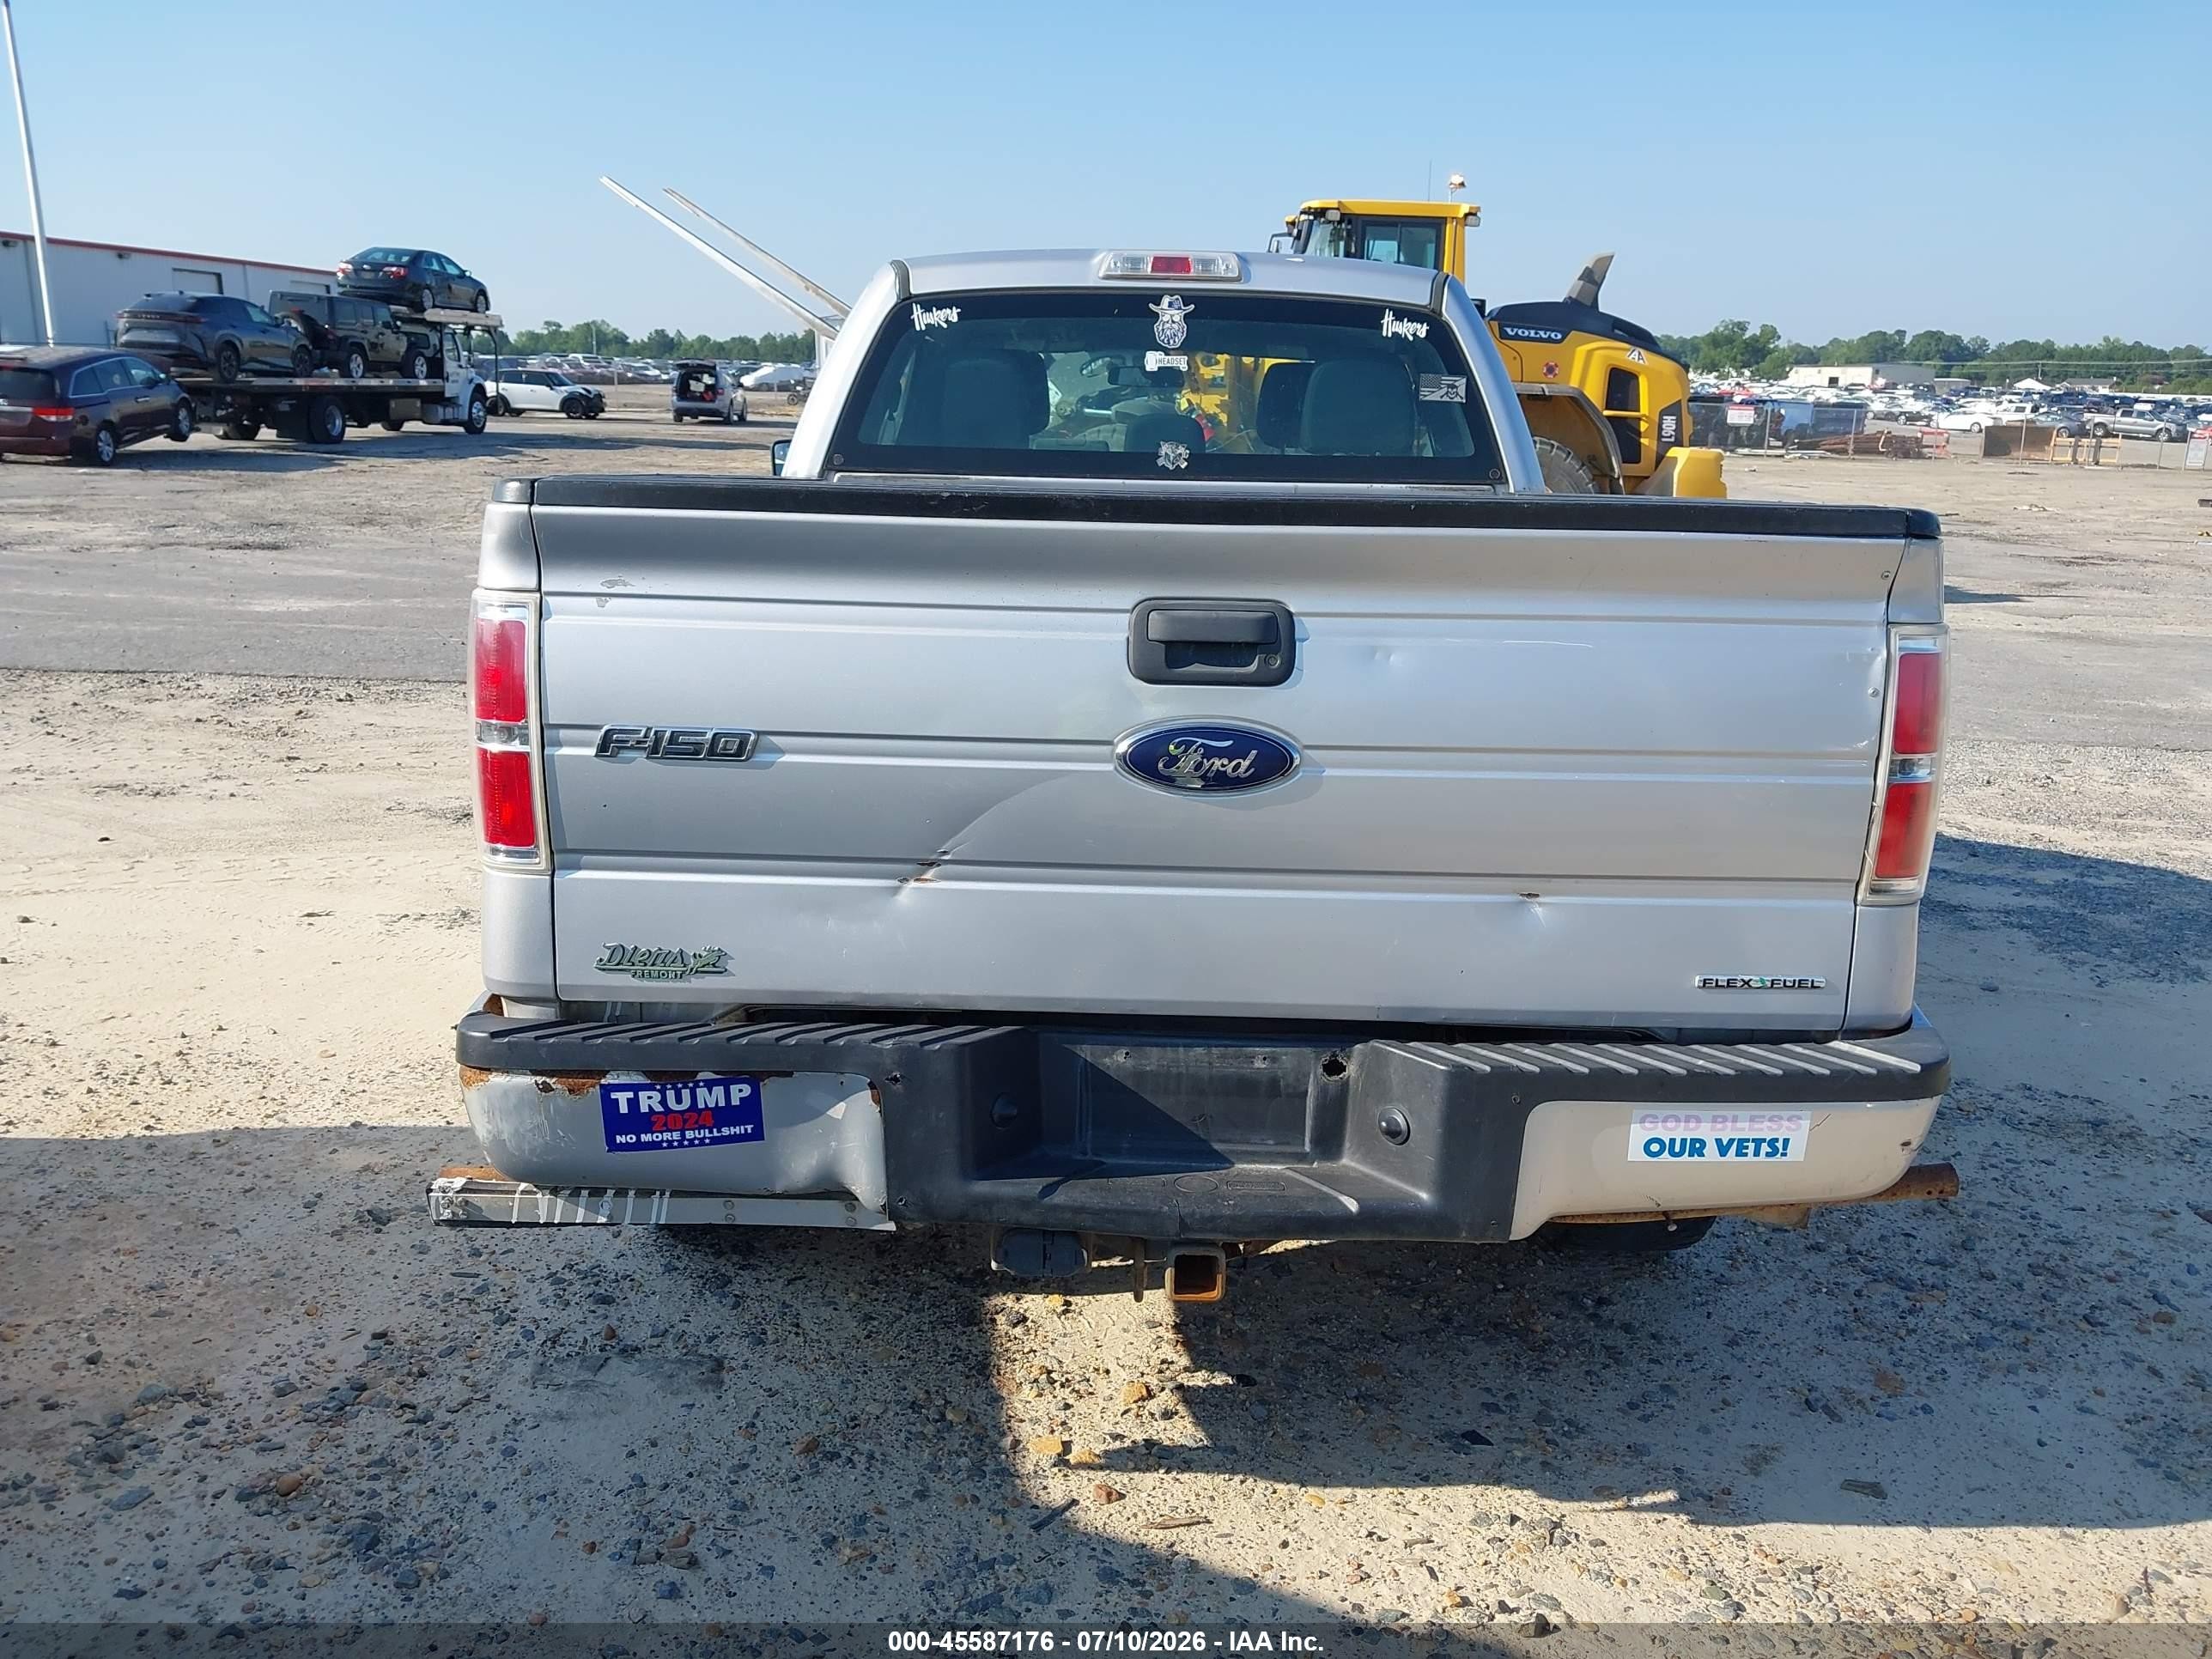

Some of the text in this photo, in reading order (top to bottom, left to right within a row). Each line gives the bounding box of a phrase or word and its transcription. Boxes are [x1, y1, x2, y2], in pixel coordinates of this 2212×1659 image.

[910, 302, 962, 331] Huskers
[1380, 308, 1430, 341] Huskers
[1504, 327, 1562, 340] VOLVO
[1158, 357, 1187, 366] HEADSET
[1661, 416, 1677, 442] L90H
[594, 725, 757, 761] F-150
[1158, 737, 1258, 779] Ford
[630, 969, 684, 979] FREMONT
[1702, 978, 1821, 988] FLEX FUEL
[611, 1084, 752, 1114] TRUMP
[651, 1110, 714, 1132] 2024
[1638, 1113, 1803, 1133] GOD BLESS
[616, 1125, 754, 1144] NO MORE BULLSHIT
[1643, 1137, 1791, 1158] OUR VETS!
